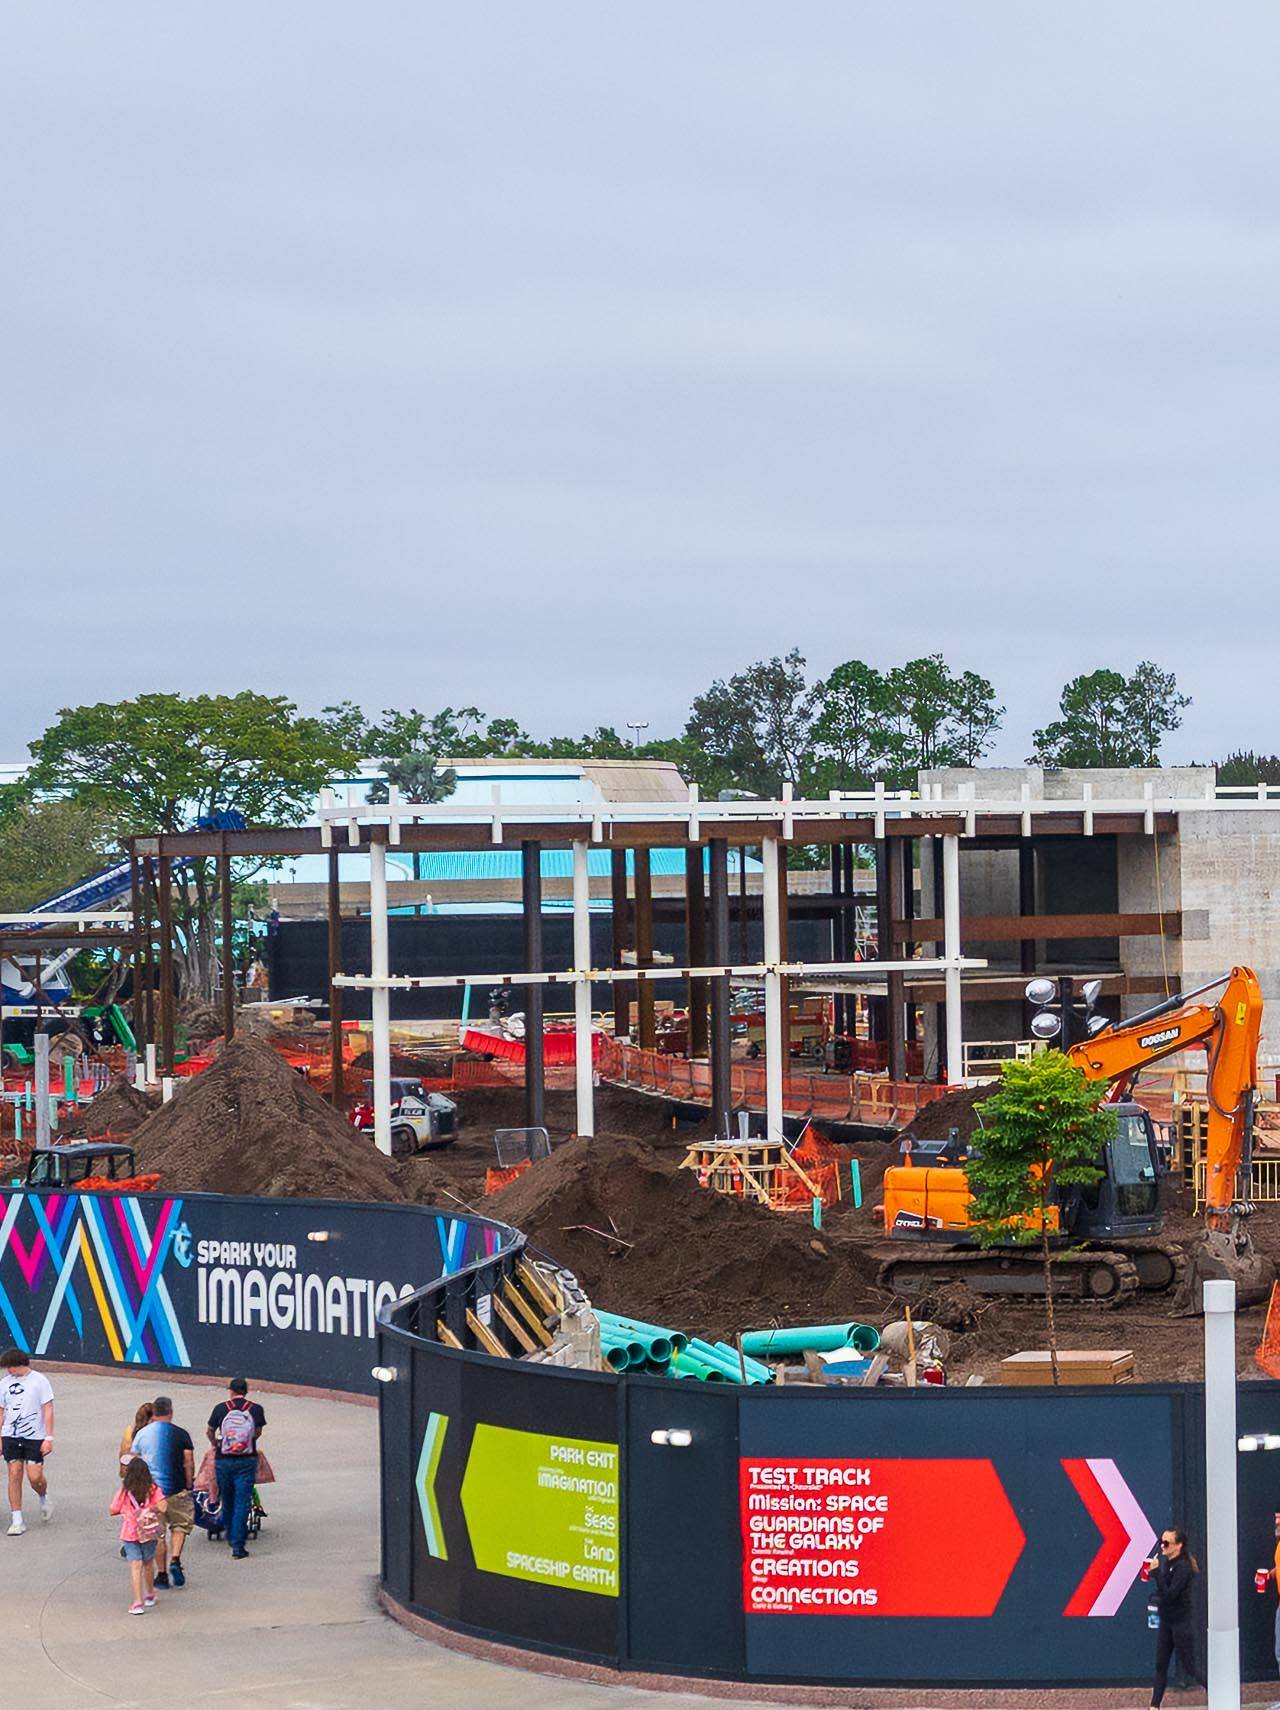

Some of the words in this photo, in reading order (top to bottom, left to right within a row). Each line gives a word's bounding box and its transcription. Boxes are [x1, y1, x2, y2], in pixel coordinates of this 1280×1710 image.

[1141, 1027, 1179, 1048] DOOSAN
[197, 1240, 251, 1266] SPARK
[253, 1243, 297, 1269] YOUR
[198, 1267, 416, 1339] IMAGINATI
[550, 1445, 585, 1465] PARK
[586, 1450, 616, 1469] EXIT
[537, 1471, 616, 1498] IMAGINATION
[748, 1467, 798, 1485] TEST
[803, 1468, 871, 1486] TRACK
[748, 1494, 822, 1511] Mission:
[825, 1495, 889, 1512] SPACE
[584, 1512, 616, 1531] SEAS
[749, 1515, 854, 1533] GUARDIANS
[857, 1517, 884, 1533] OF
[749, 1533, 786, 1549] THE
[788, 1533, 864, 1550] GALAXY
[583, 1542, 616, 1563] LAND
[506, 1551, 571, 1577] SPACESHIP
[572, 1565, 617, 1587] EARTH
[750, 1558, 860, 1578] CREATIONS
[750, 1586, 878, 1606] CONNECTIONS
